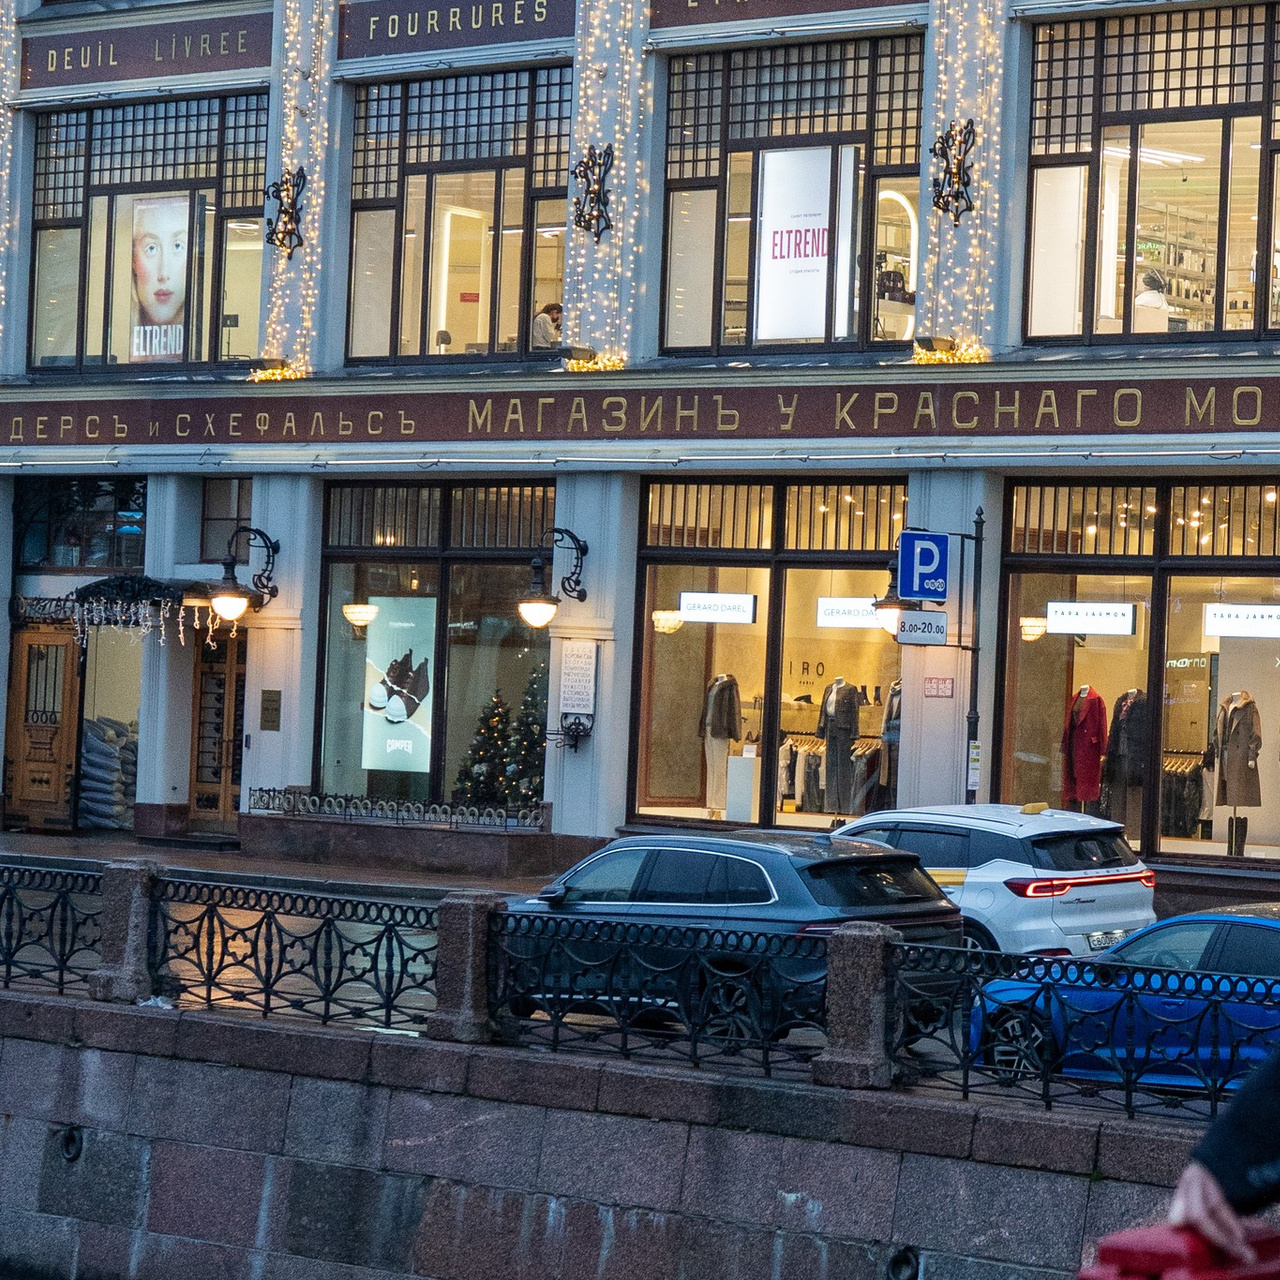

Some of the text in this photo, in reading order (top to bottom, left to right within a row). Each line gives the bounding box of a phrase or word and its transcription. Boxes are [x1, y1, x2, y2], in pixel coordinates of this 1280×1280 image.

[48, 30, 248, 71] DEUIL LIVREE
[772, 228, 828, 259] ELTREND
[132, 325, 184, 356] ELTREND
[468, 394, 740, 433] МАГАЗИНЪ
[778, 394, 798, 431] У
[835, 388, 1142, 430] КРАСНАГО
[176, 410, 416, 438] СХЕФАЛЬСЪ
[686, 603, 746, 613] GERARD DAREL
[824, 608, 860, 617] GERARD
[900, 622, 945, 634] 8.00-20.00
[789, 661, 825, 676] IRO
[386, 739, 413, 755] CAMPER
